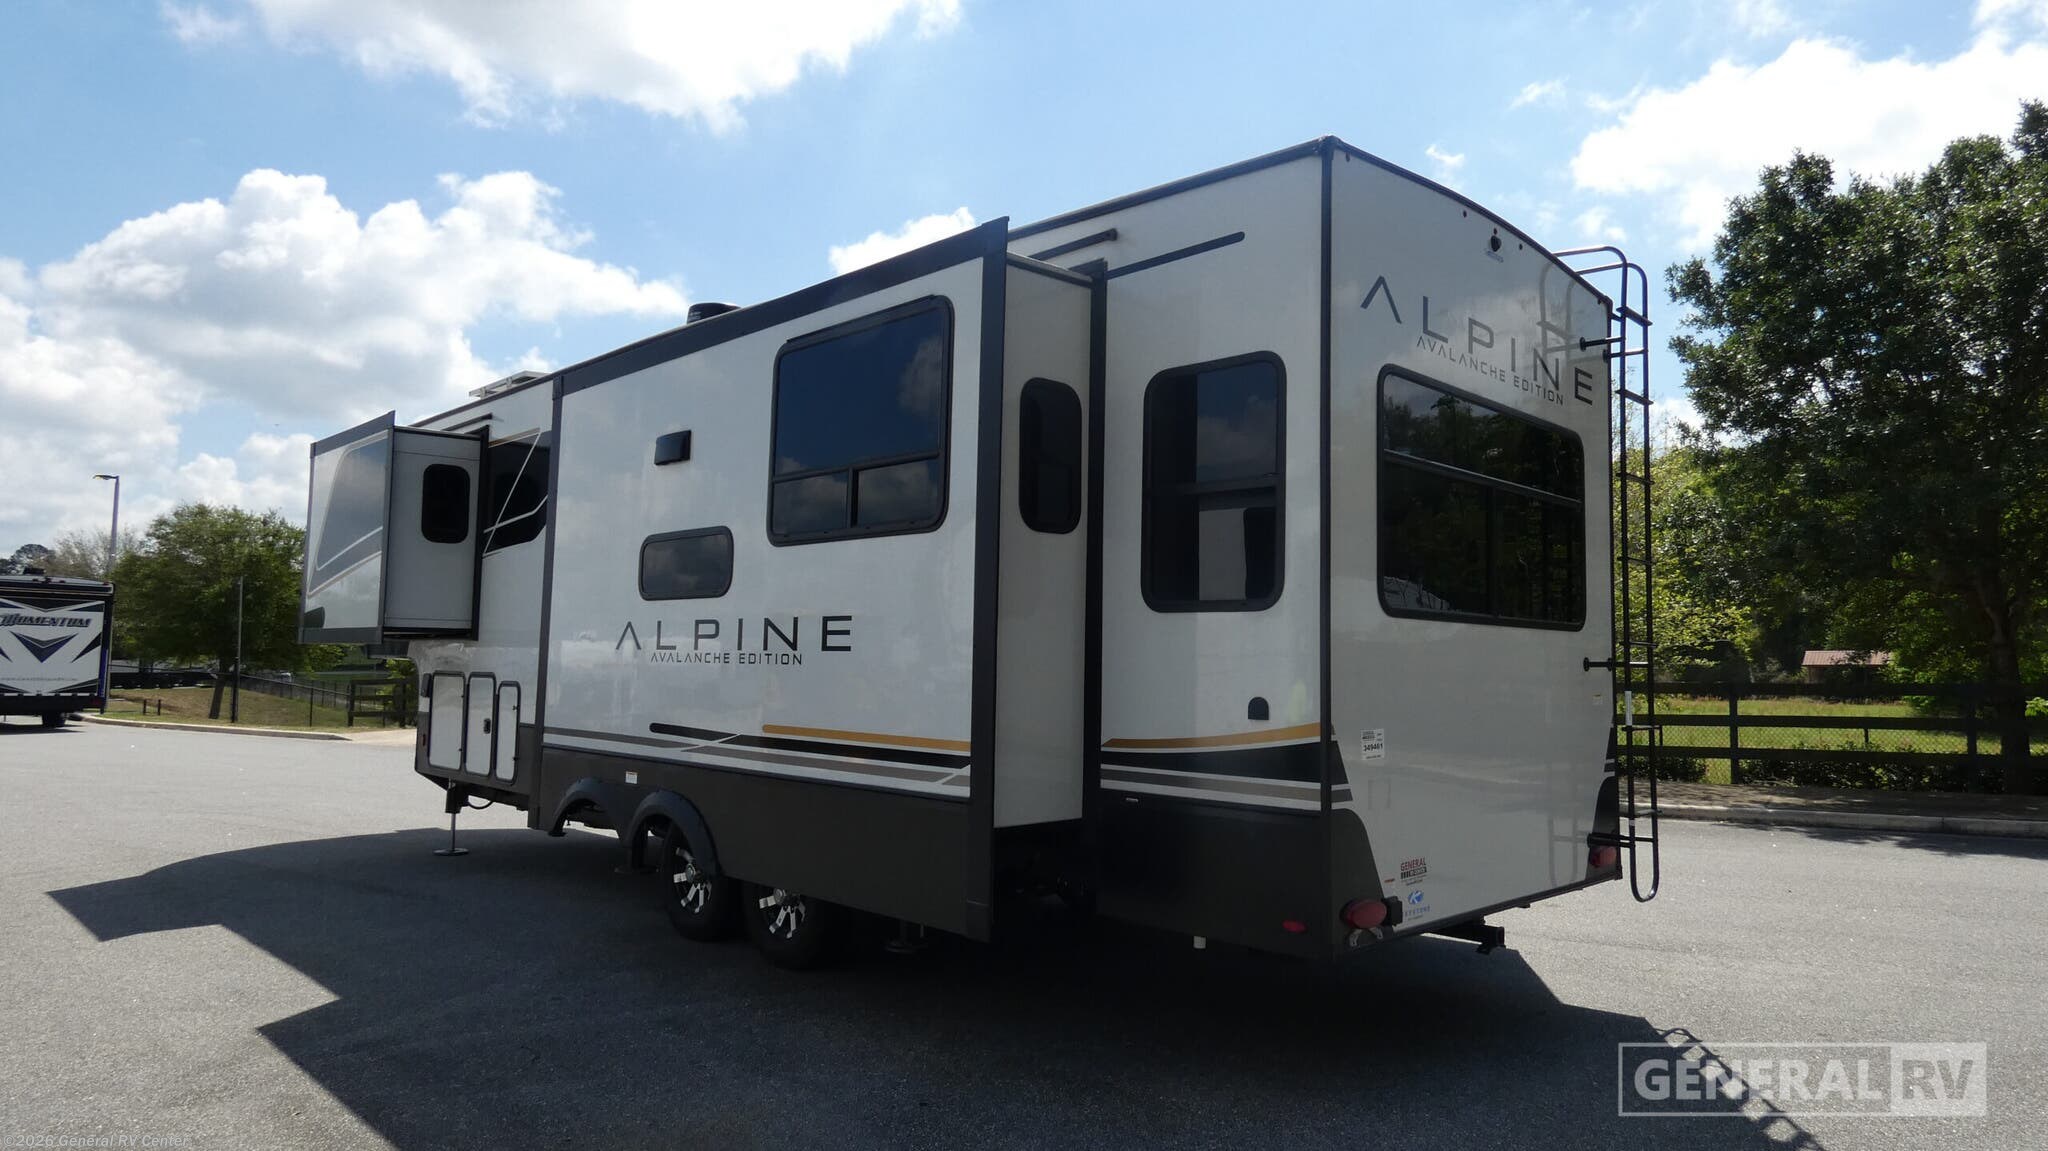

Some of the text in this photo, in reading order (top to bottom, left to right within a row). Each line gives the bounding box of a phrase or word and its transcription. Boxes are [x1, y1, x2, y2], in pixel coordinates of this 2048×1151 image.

[1360, 275, 1593, 405] ALPINE
[1416, 335, 1564, 406] AVALANCHE EDITION
[615, 615, 853, 652] ALPINE
[650, 652, 803, 665] AVALANCHE EDITION
